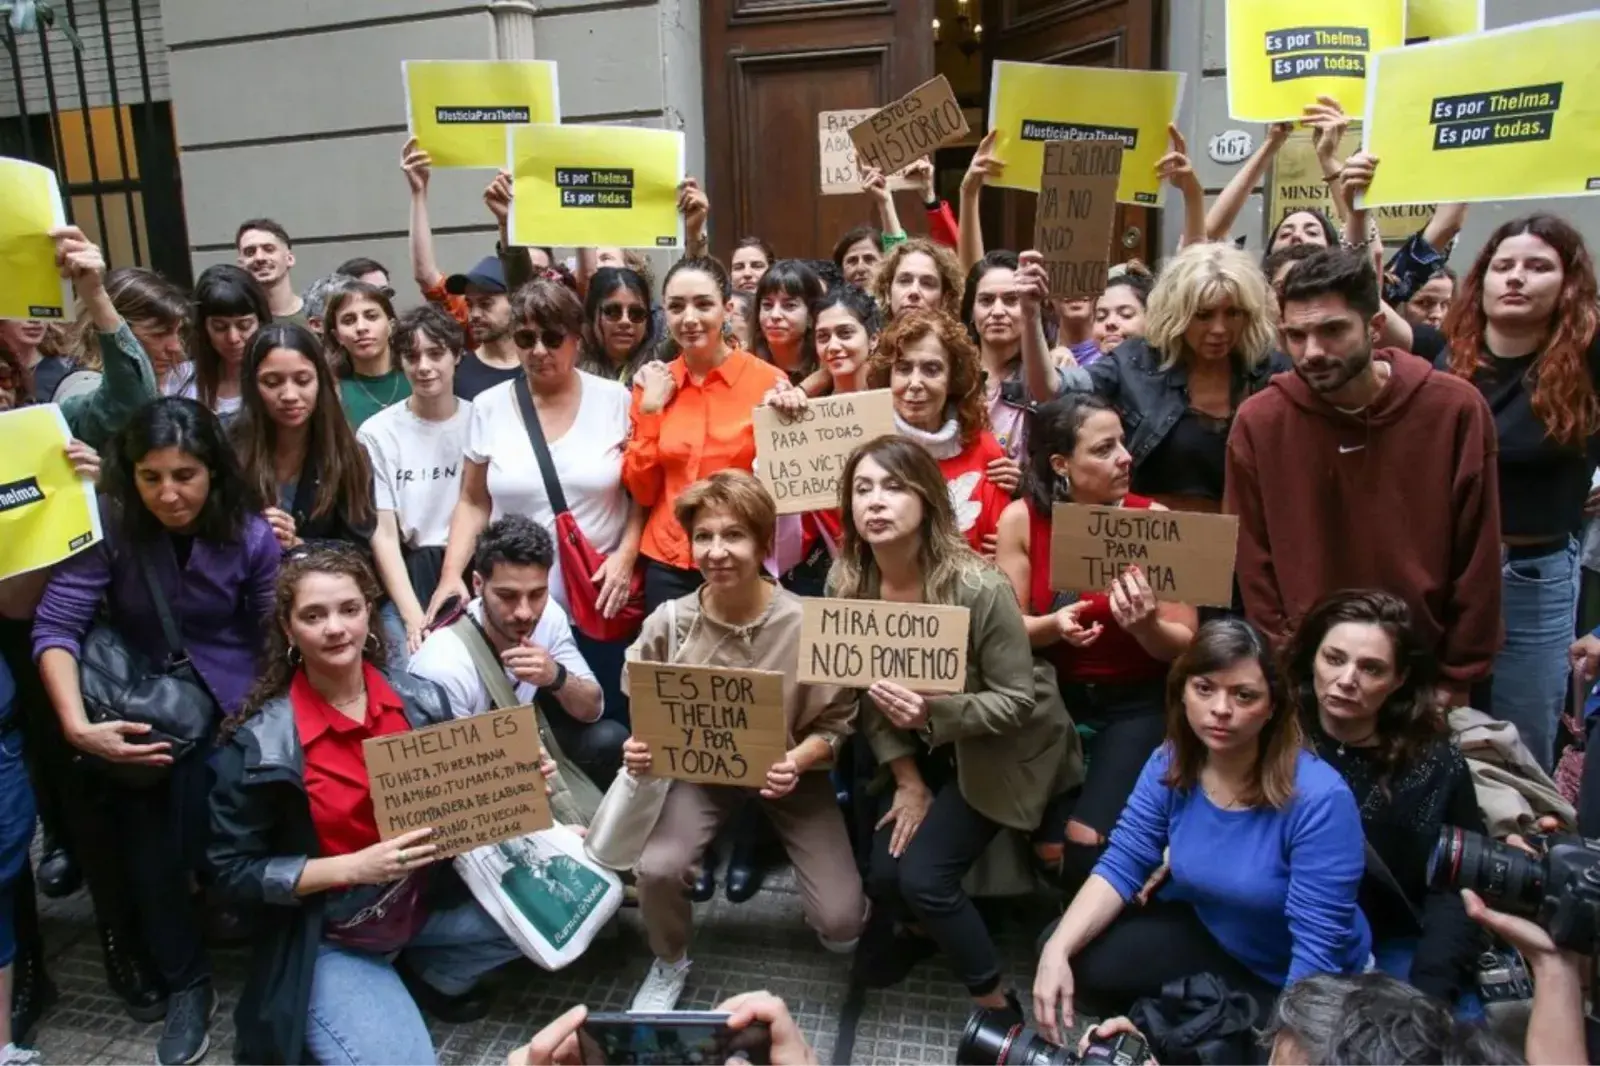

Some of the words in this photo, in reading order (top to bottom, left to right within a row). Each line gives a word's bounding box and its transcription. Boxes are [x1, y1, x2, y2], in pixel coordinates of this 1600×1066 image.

[1266, 35, 1282, 50] Es
[1287, 33, 1311, 50] por
[1314, 30, 1366, 47] Thelma.
[1275, 59, 1291, 75] Es
[1296, 57, 1320, 74] por
[1324, 55, 1364, 71] todas.
[437, 108, 528, 121] #JusticiaParaThelma
[1434, 101, 1452, 118] Es
[1456, 99, 1485, 118] por
[1489, 91, 1554, 112] Thelma.
[1439, 127, 1457, 144] Es
[1461, 125, 1490, 144] por
[1494, 119, 1545, 139] todas.
[1216, 137, 1246, 156] 667
[557, 171, 569, 184] Es
[573, 173, 589, 185] por
[591, 171, 630, 185] Thelma.
[564, 191, 575, 203] Es
[578, 193, 595, 205] por
[598, 192, 629, 204] todas.
[1067, 188, 1092, 220] NO
[771, 430, 808, 452] PARA
[815, 424, 863, 442] TODAS
[769, 459, 802, 480] LAS
[1104, 539, 1148, 559] PARA
[1081, 556, 1176, 591] THEMA
[811, 642, 863, 678] NOS
[871, 645, 960, 680] PONEMOS
[655, 671, 699, 700] ES
[711, 675, 755, 704] POR
[661, 701, 748, 730] THELMA
[377, 724, 481, 763] THELMA
[492, 714, 518, 739] ES
[680, 727, 694, 746] Y
[703, 729, 737, 752] POR
[662, 746, 748, 779] TODAS
